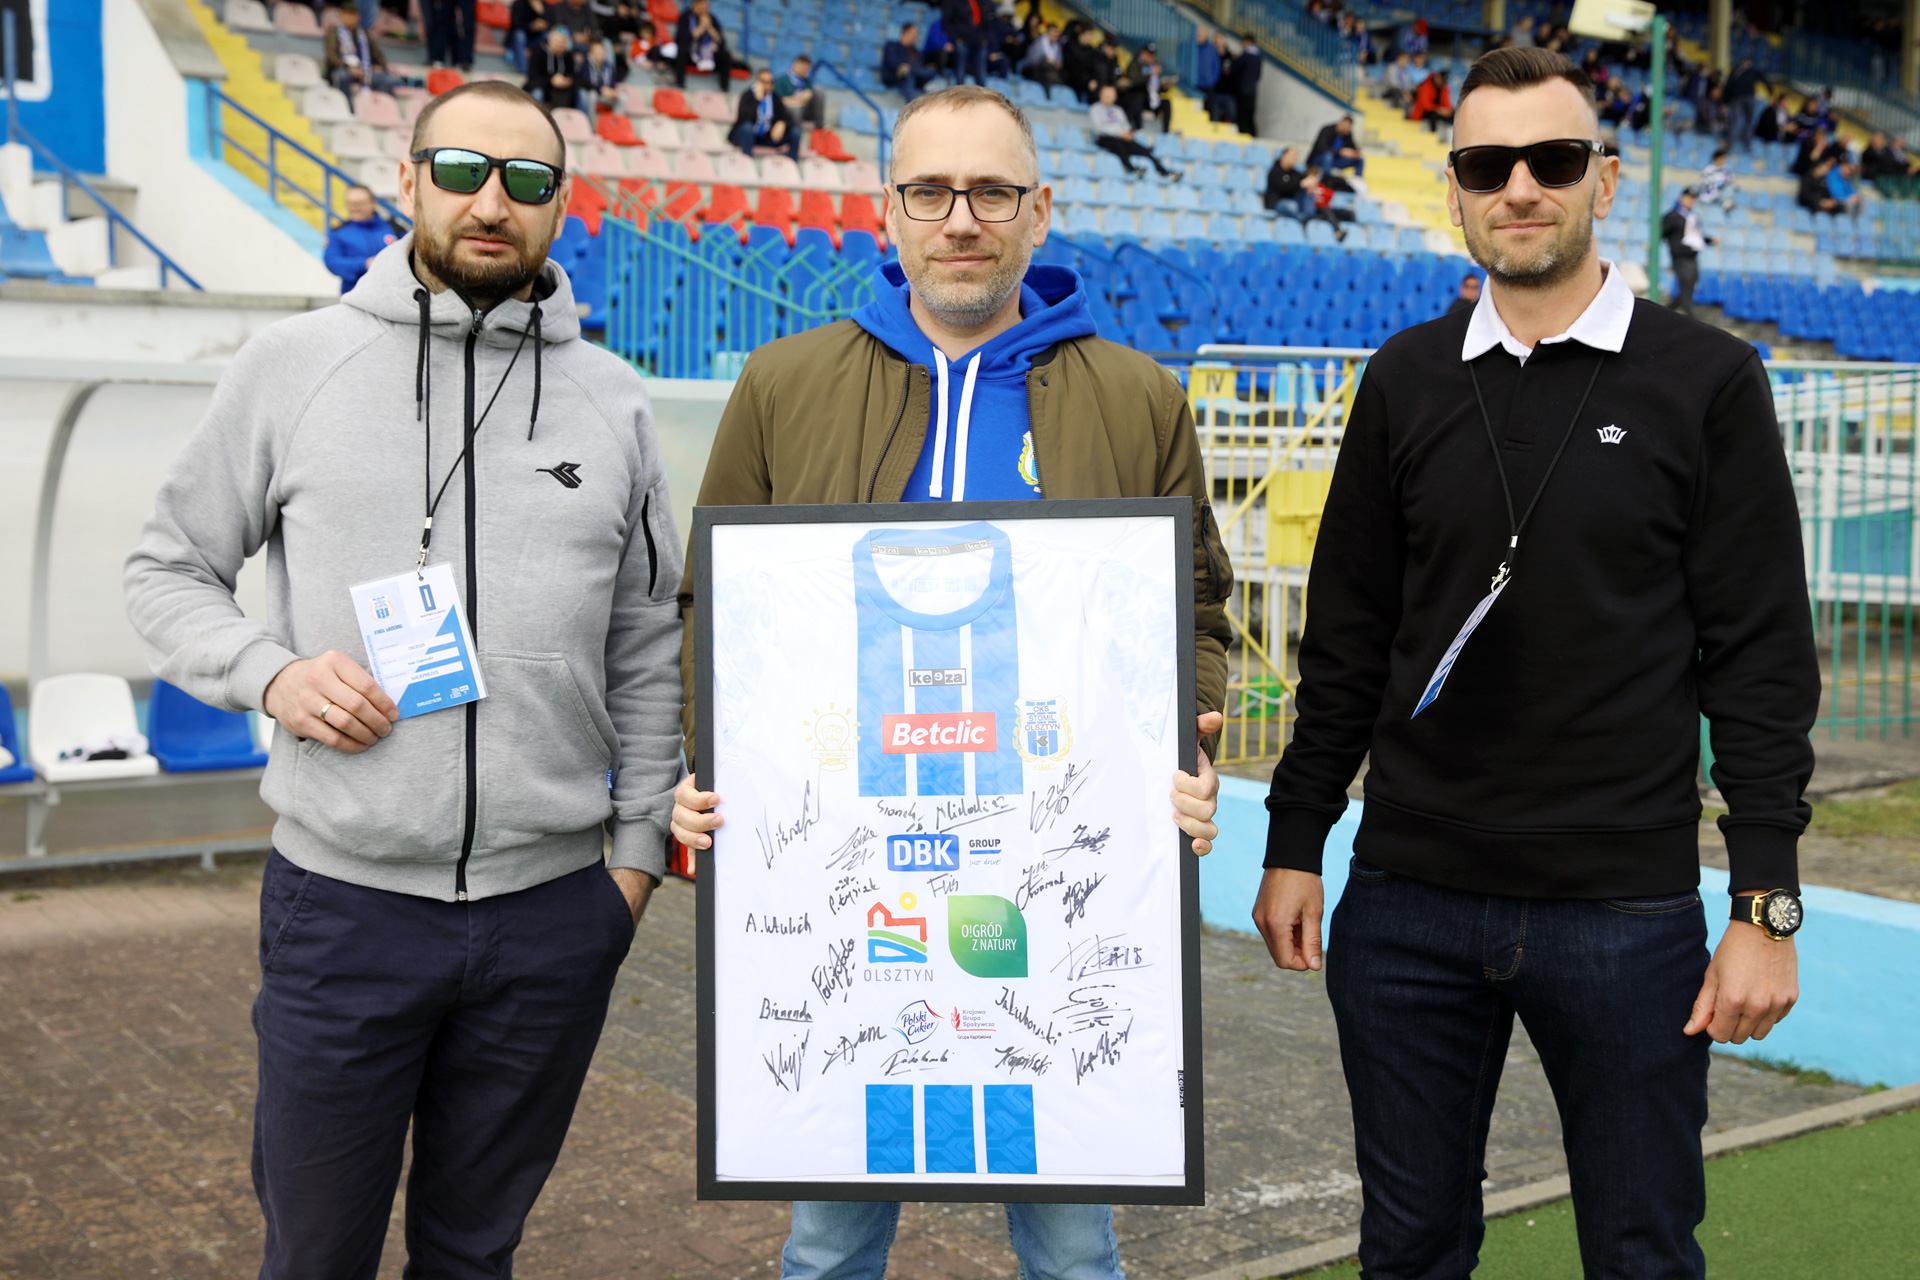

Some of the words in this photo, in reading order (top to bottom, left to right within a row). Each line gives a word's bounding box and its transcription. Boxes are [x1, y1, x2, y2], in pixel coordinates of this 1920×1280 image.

[892, 719, 986, 746] Betclic
[969, 839, 1001, 847] GROUP
[893, 839, 954, 866] DBK
[972, 939, 978, 951] Z
[980, 939, 1017, 951] NATURY
[863, 969, 934, 982] OLSZTYN
[901, 1010, 927, 1028] Polski
[962, 1009, 986, 1017] Krajowa
[907, 1021, 935, 1037] Cukier
